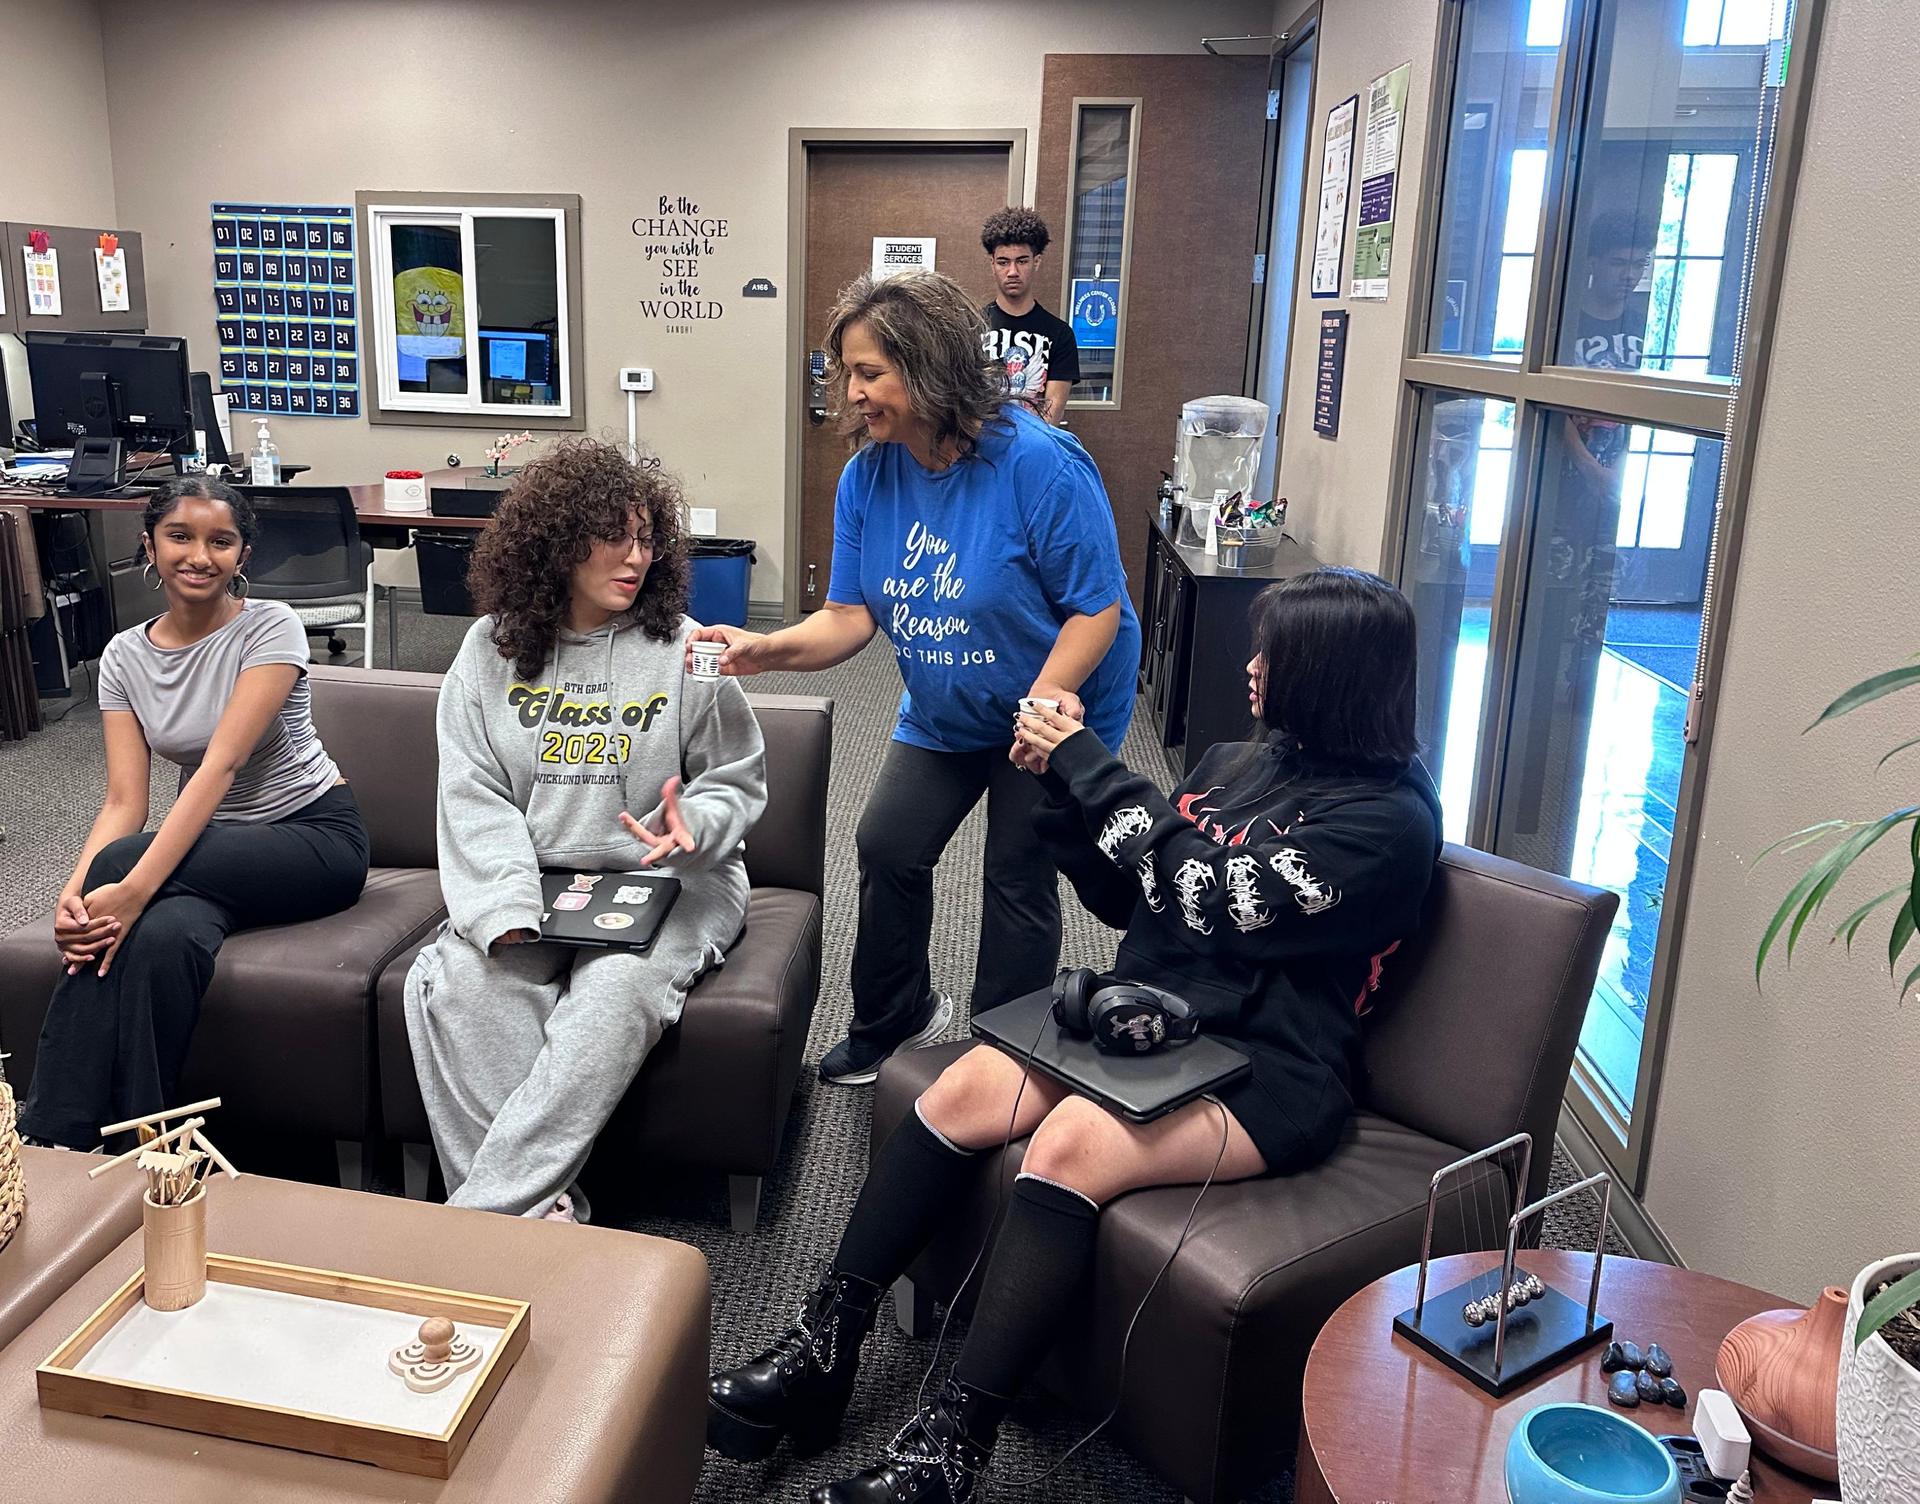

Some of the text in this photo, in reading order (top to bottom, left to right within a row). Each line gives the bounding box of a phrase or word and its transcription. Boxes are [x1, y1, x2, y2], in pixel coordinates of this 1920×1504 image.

[659, 195, 700, 216] Be the
[217, 228, 344, 243] 01 02 03 04 05 06
[632, 218, 729, 238] CHANGE
[644, 238, 715, 261] you wish to
[886, 244, 922, 253] STUDENT
[884, 254, 923, 264] SERVICES
[220, 262, 346, 278] 07 08 09 10 11 12
[662, 259, 699, 278] SEE
[660, 279, 701, 297] in the
[221, 294, 348, 311] 13 14 15 16 17 18
[641, 300, 723, 320] WORLD
[1075, 290, 1118, 316] WELLNESS CENTER CLOSED
[222, 328, 348, 344] 19 20 21 22 23 24
[666, 324, 693, 334] GANDHI
[223, 361, 349, 376] 25 26 27 28 29 30
[229, 393, 350, 408] 31 32 33 34 35 36
[903, 521, 950, 570] You
[882, 552, 966, 602] are the
[892, 602, 970, 641] Reason
[917, 649, 954, 665] THIS
[961, 649, 996, 666] JOB
[564, 682, 613, 694] 8TH GRAD
[508, 683, 669, 733] Class of
[541, 731, 632, 765] 2023
[535, 773, 628, 785] WICKLUND WILDCAT
